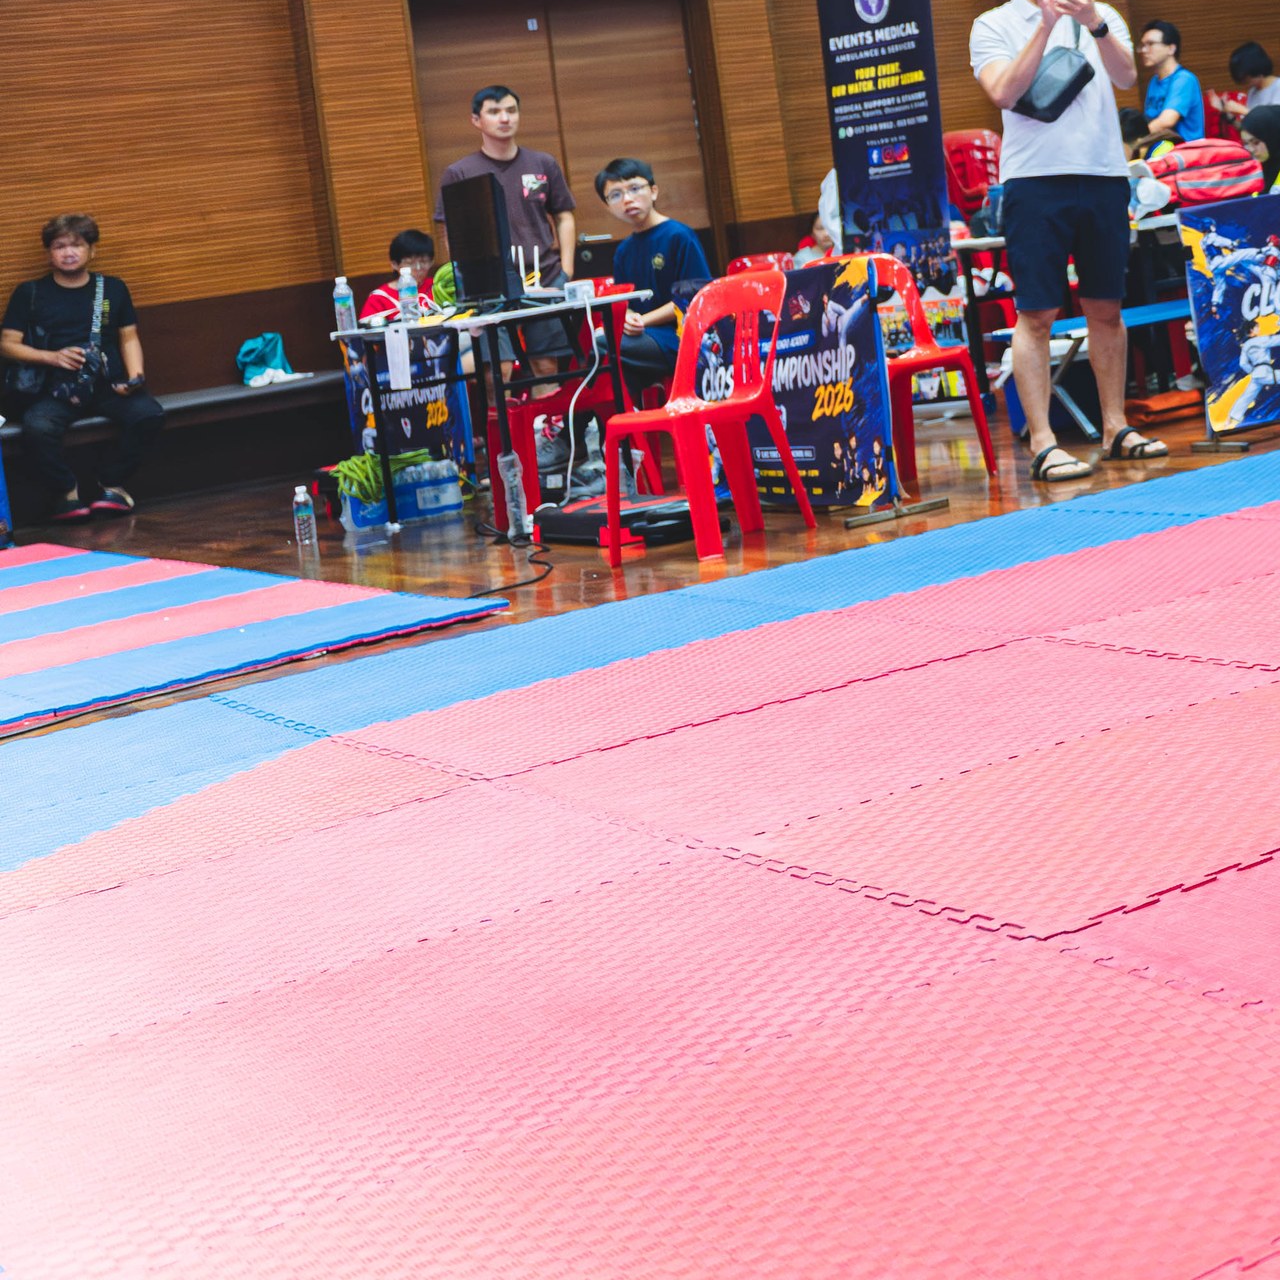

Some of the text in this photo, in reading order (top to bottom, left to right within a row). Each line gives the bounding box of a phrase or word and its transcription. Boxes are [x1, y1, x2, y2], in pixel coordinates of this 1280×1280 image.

[829, 21, 920, 51] EVENTS MEDICAL
[701, 364, 735, 402] CLOS
[811, 376, 855, 422] 2026
